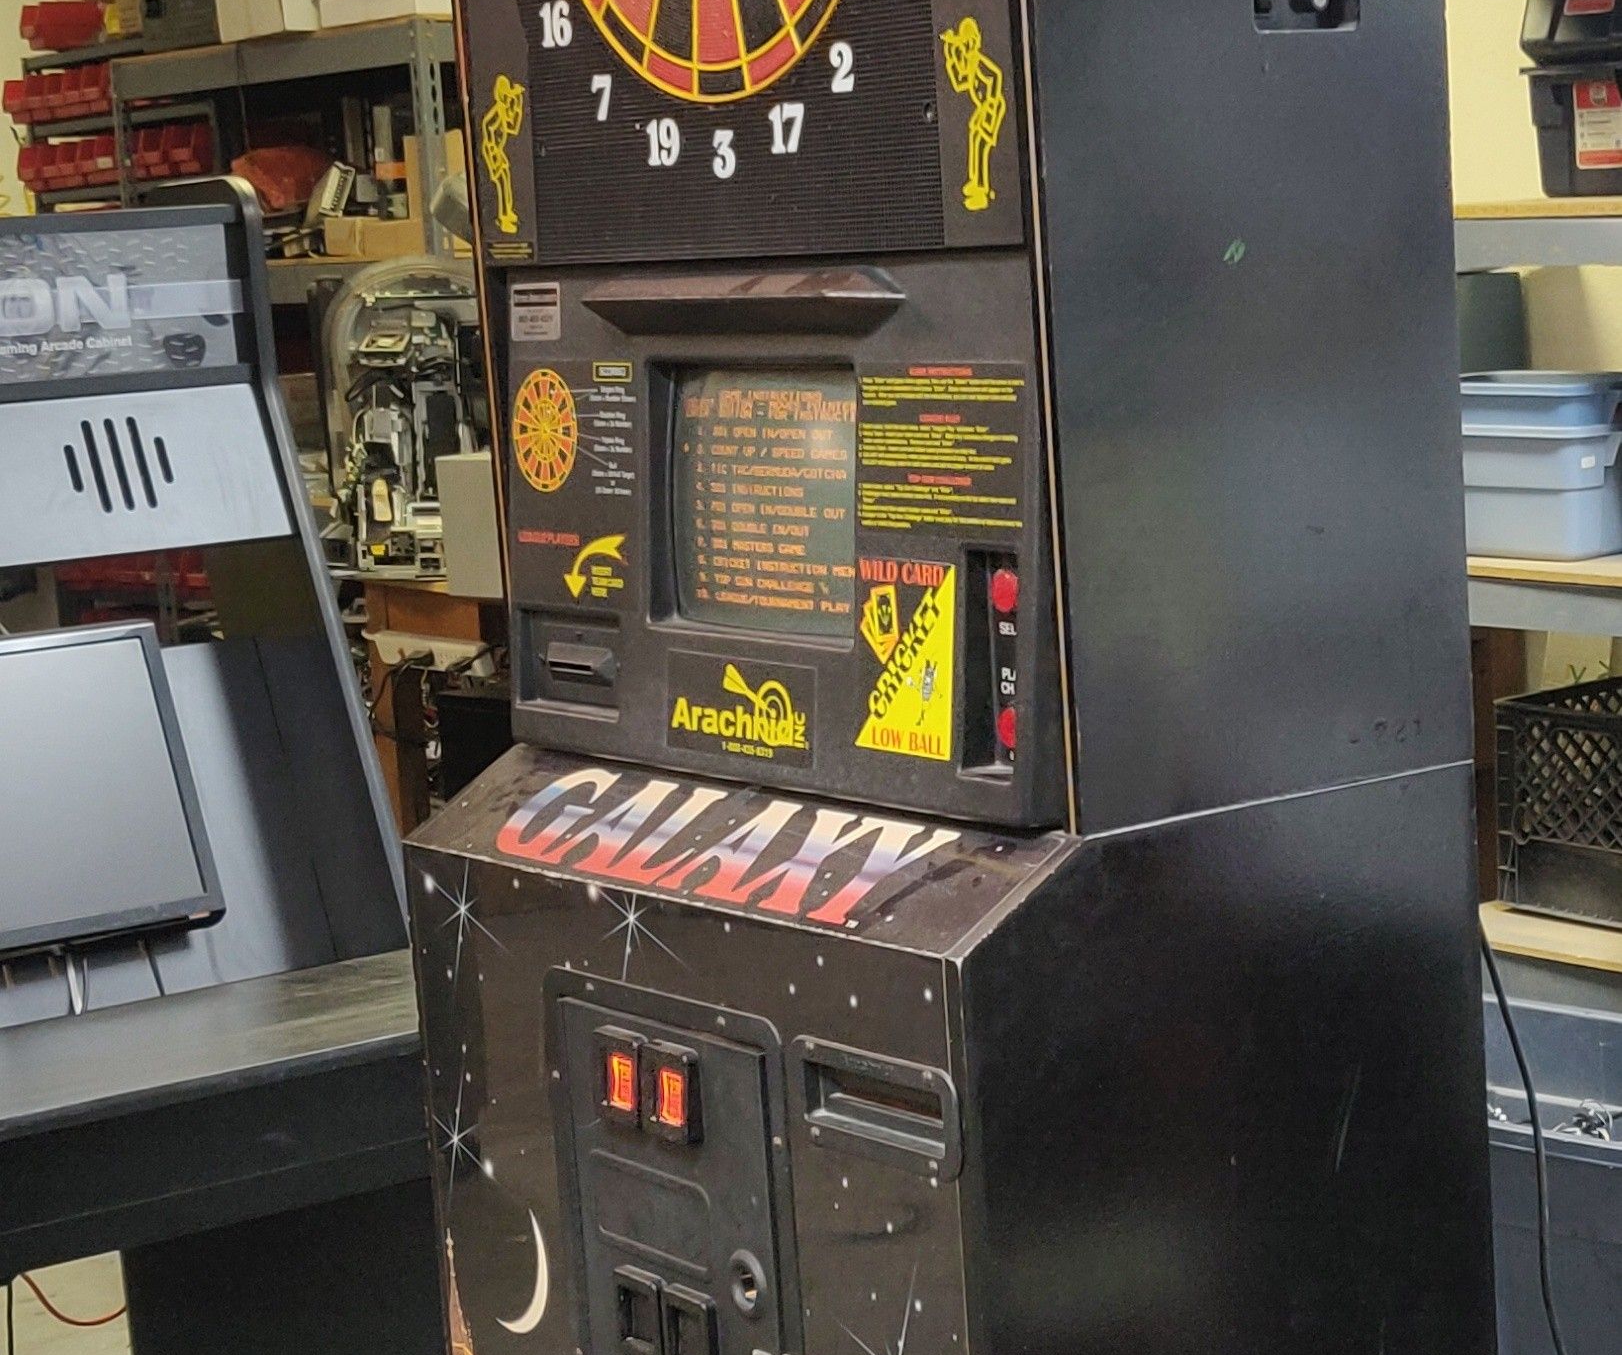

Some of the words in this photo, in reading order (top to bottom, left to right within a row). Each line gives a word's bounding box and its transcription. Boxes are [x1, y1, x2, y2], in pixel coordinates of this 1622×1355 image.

[539, 0, 573, 48] 16
[829, 41, 855, 93] 2
[591, 74, 612, 122] 7
[645, 117, 681, 167] 19
[768, 102, 805, 155] 17
[712, 129, 736, 179] 3
[822, 507, 847, 521] OUT
[859, 557, 898, 583] WILD
[901, 562, 945, 588] CARD
[868, 588, 940, 720] CRICKET
[671, 696, 794, 748] Arachnid
[871, 727, 902, 748] LOW
[908, 731, 945, 756] BALL
[495, 767, 963, 927] GALAXY
